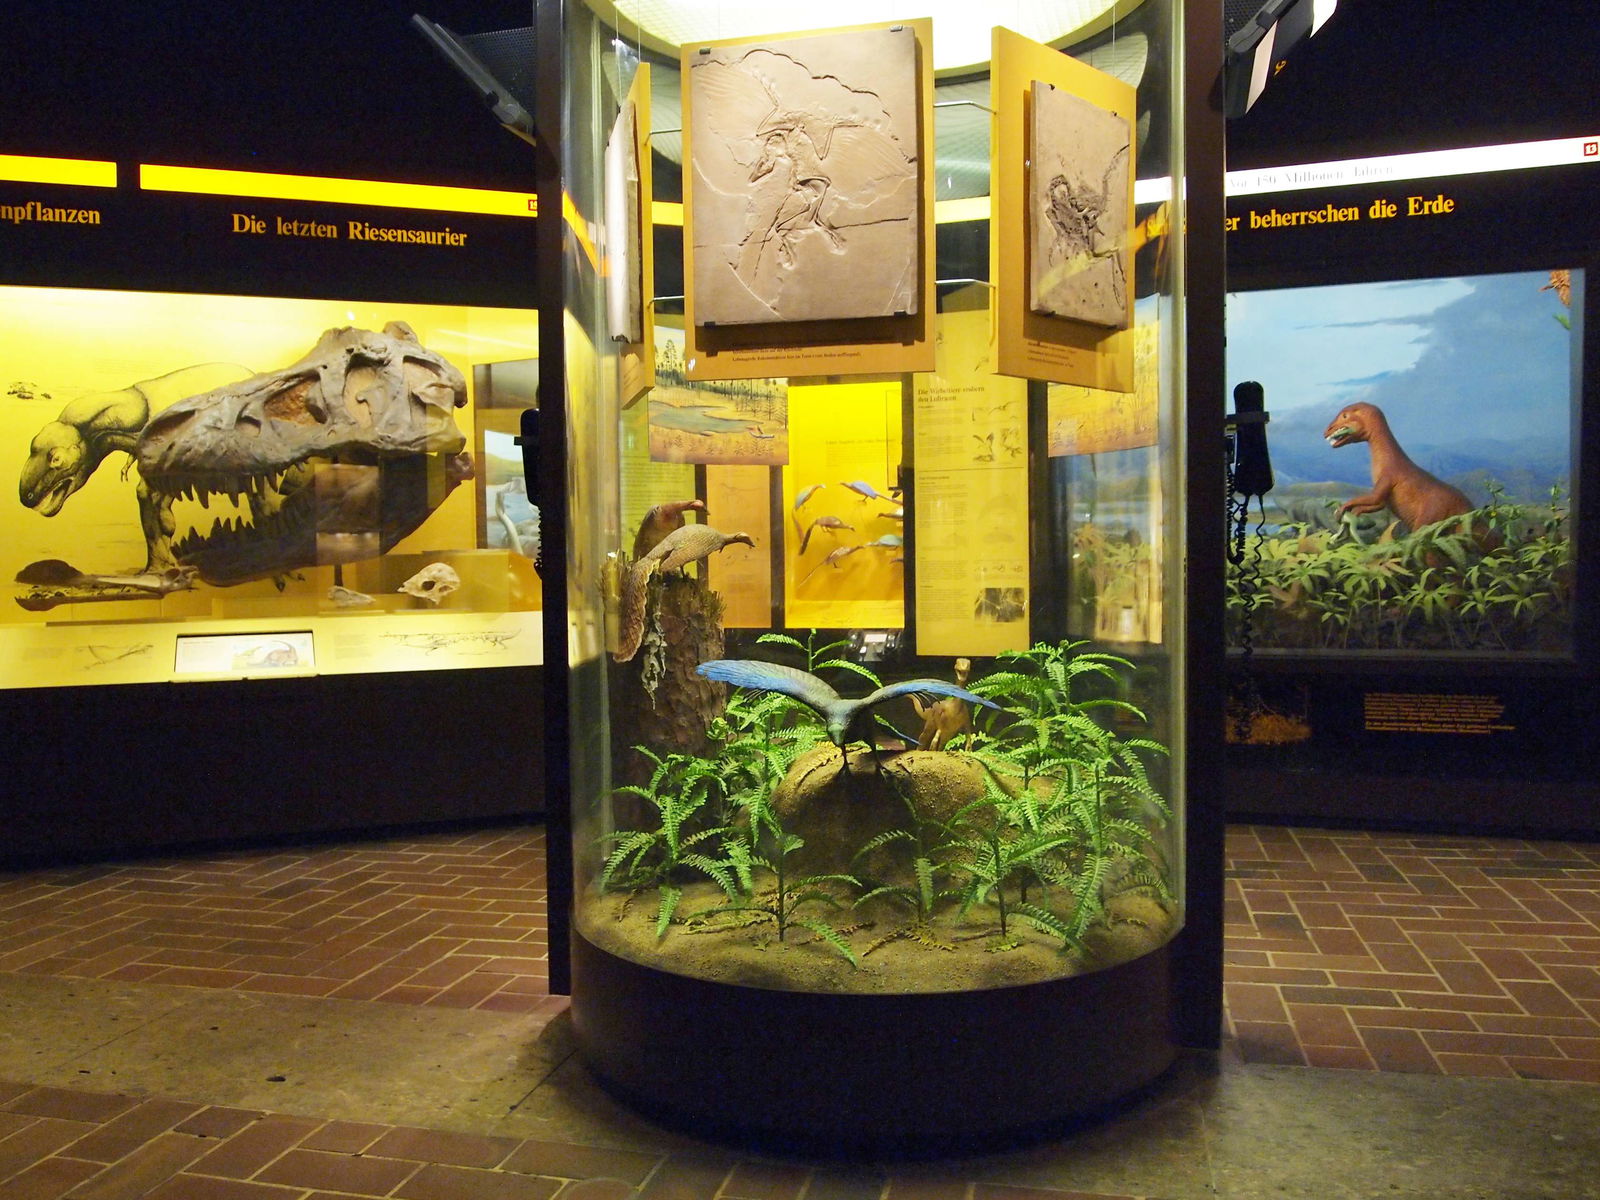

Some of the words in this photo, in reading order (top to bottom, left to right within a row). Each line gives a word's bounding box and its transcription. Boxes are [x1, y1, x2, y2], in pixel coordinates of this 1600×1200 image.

[1256, 175, 1278, 187] 150
[1285, 169, 1345, 184] Millionen
[1354, 164, 1394, 178] Jahren
[1250, 204, 1360, 229] beherrschen
[1369, 199, 1398, 219] die
[1407, 194, 1455, 216] Erde
[232, 213, 267, 234] Die
[276, 216, 338, 238] letzten
[348, 221, 468, 246] Riesensaurier
